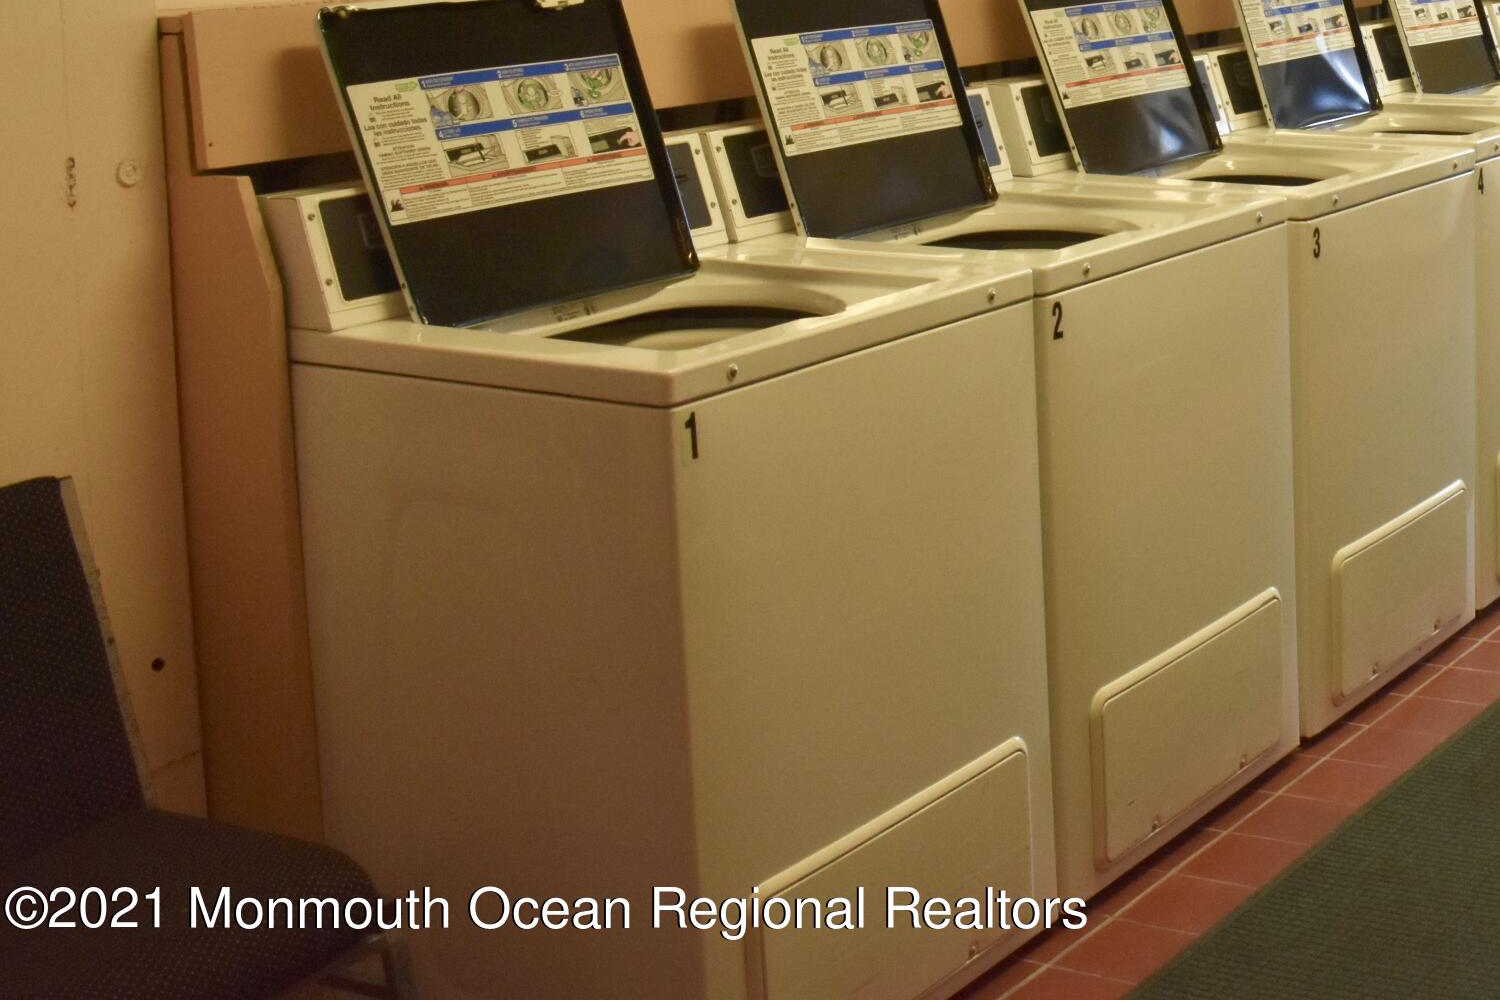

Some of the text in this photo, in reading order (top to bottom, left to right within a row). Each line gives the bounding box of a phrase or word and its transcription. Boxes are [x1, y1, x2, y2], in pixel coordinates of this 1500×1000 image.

[1477, 167, 1484, 195] 4
[1312, 227, 1321, 259] 3
[1052, 301, 1064, 340] 2
[684, 411, 699, 460] 1
